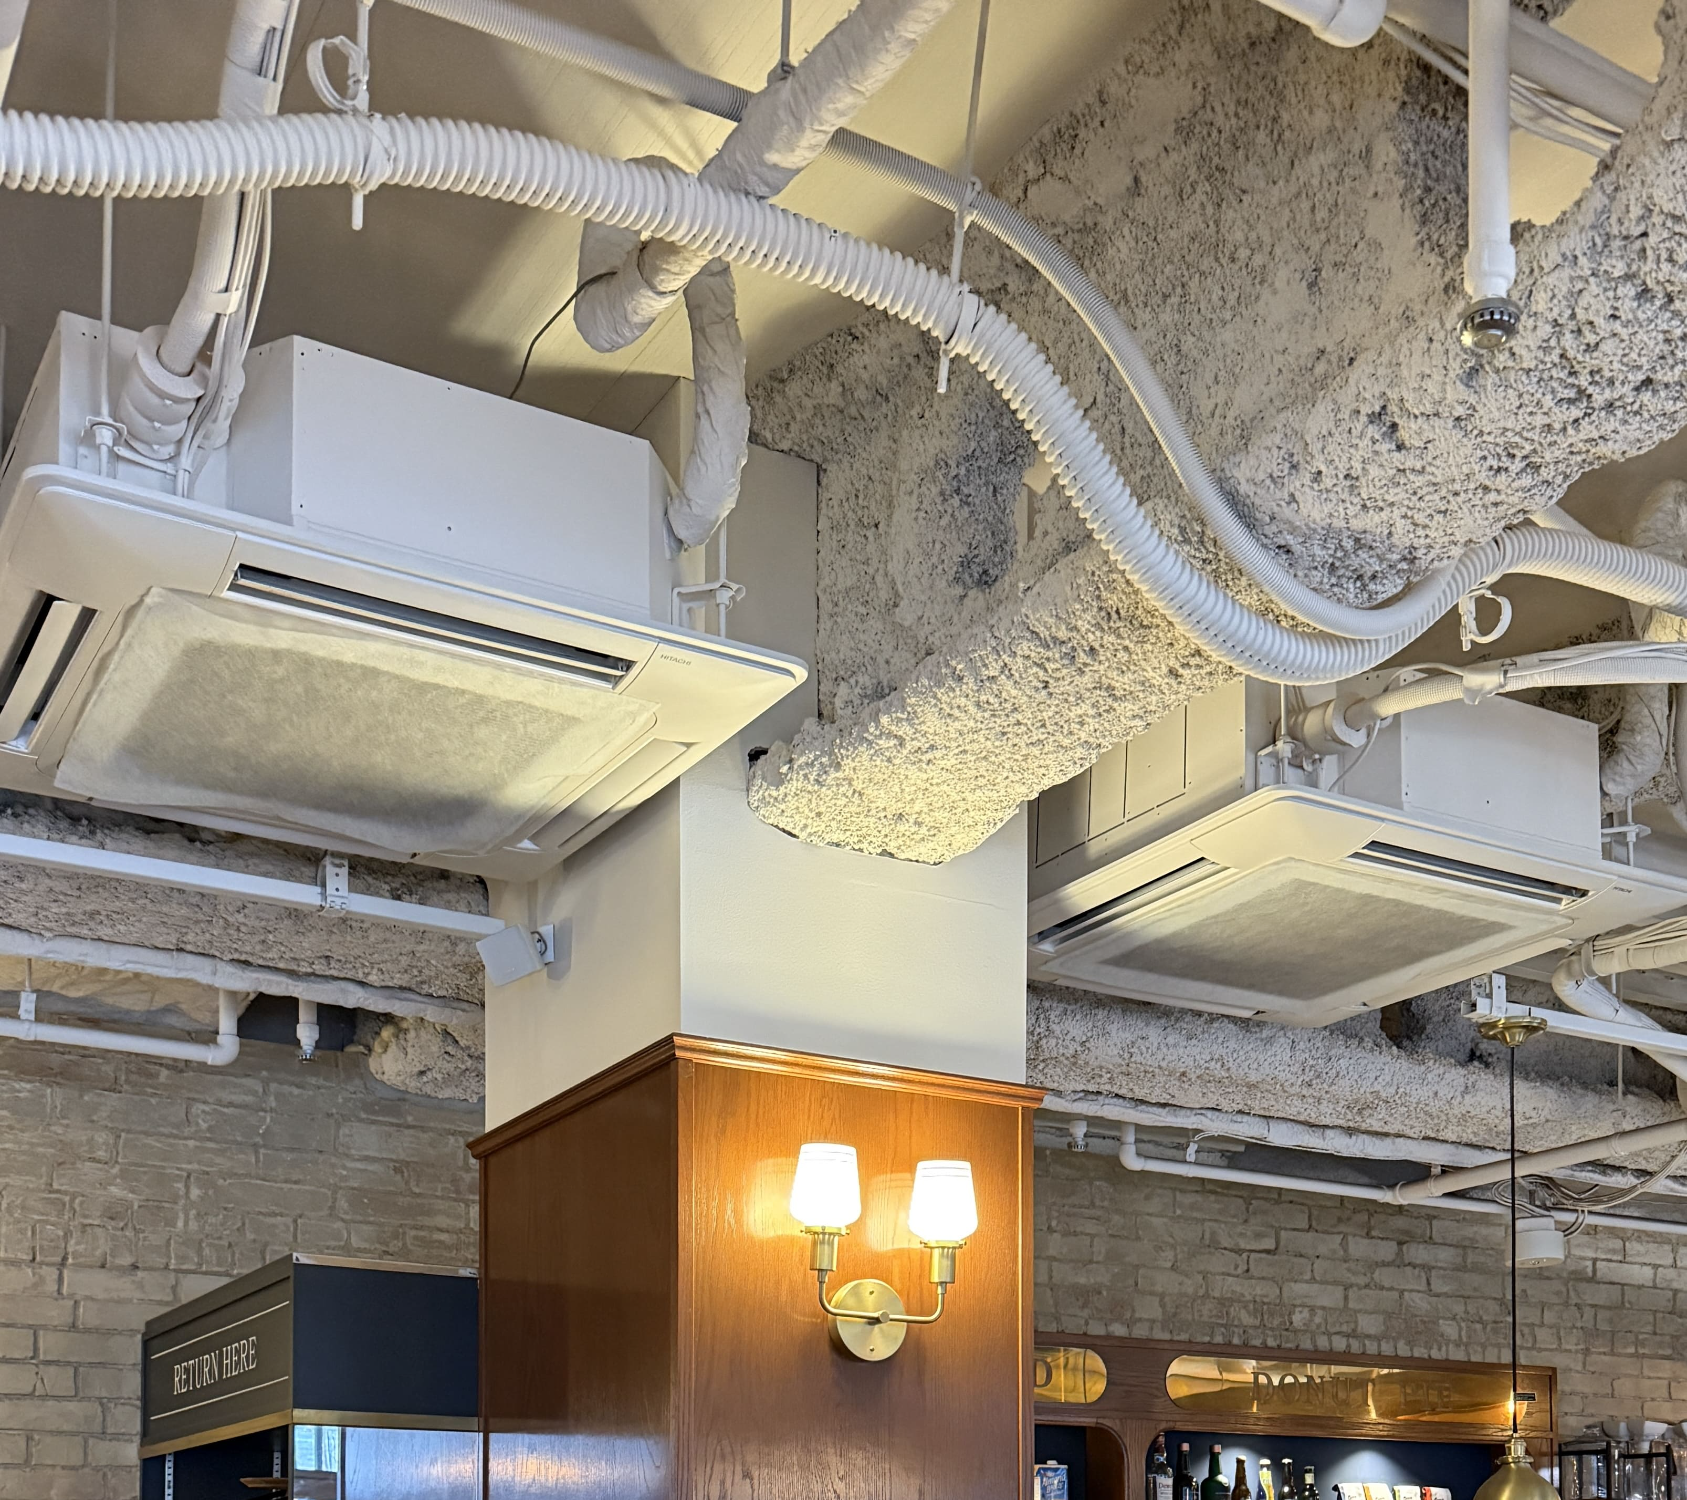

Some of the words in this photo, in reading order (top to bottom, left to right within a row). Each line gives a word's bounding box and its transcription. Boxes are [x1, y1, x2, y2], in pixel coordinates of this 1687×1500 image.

[660, 653, 692, 666] HITACHI
[173, 1350, 219, 1395] RETURN
[222, 1336, 258, 1380] HERE
[1251, 1371, 1377, 1408] DONUT
